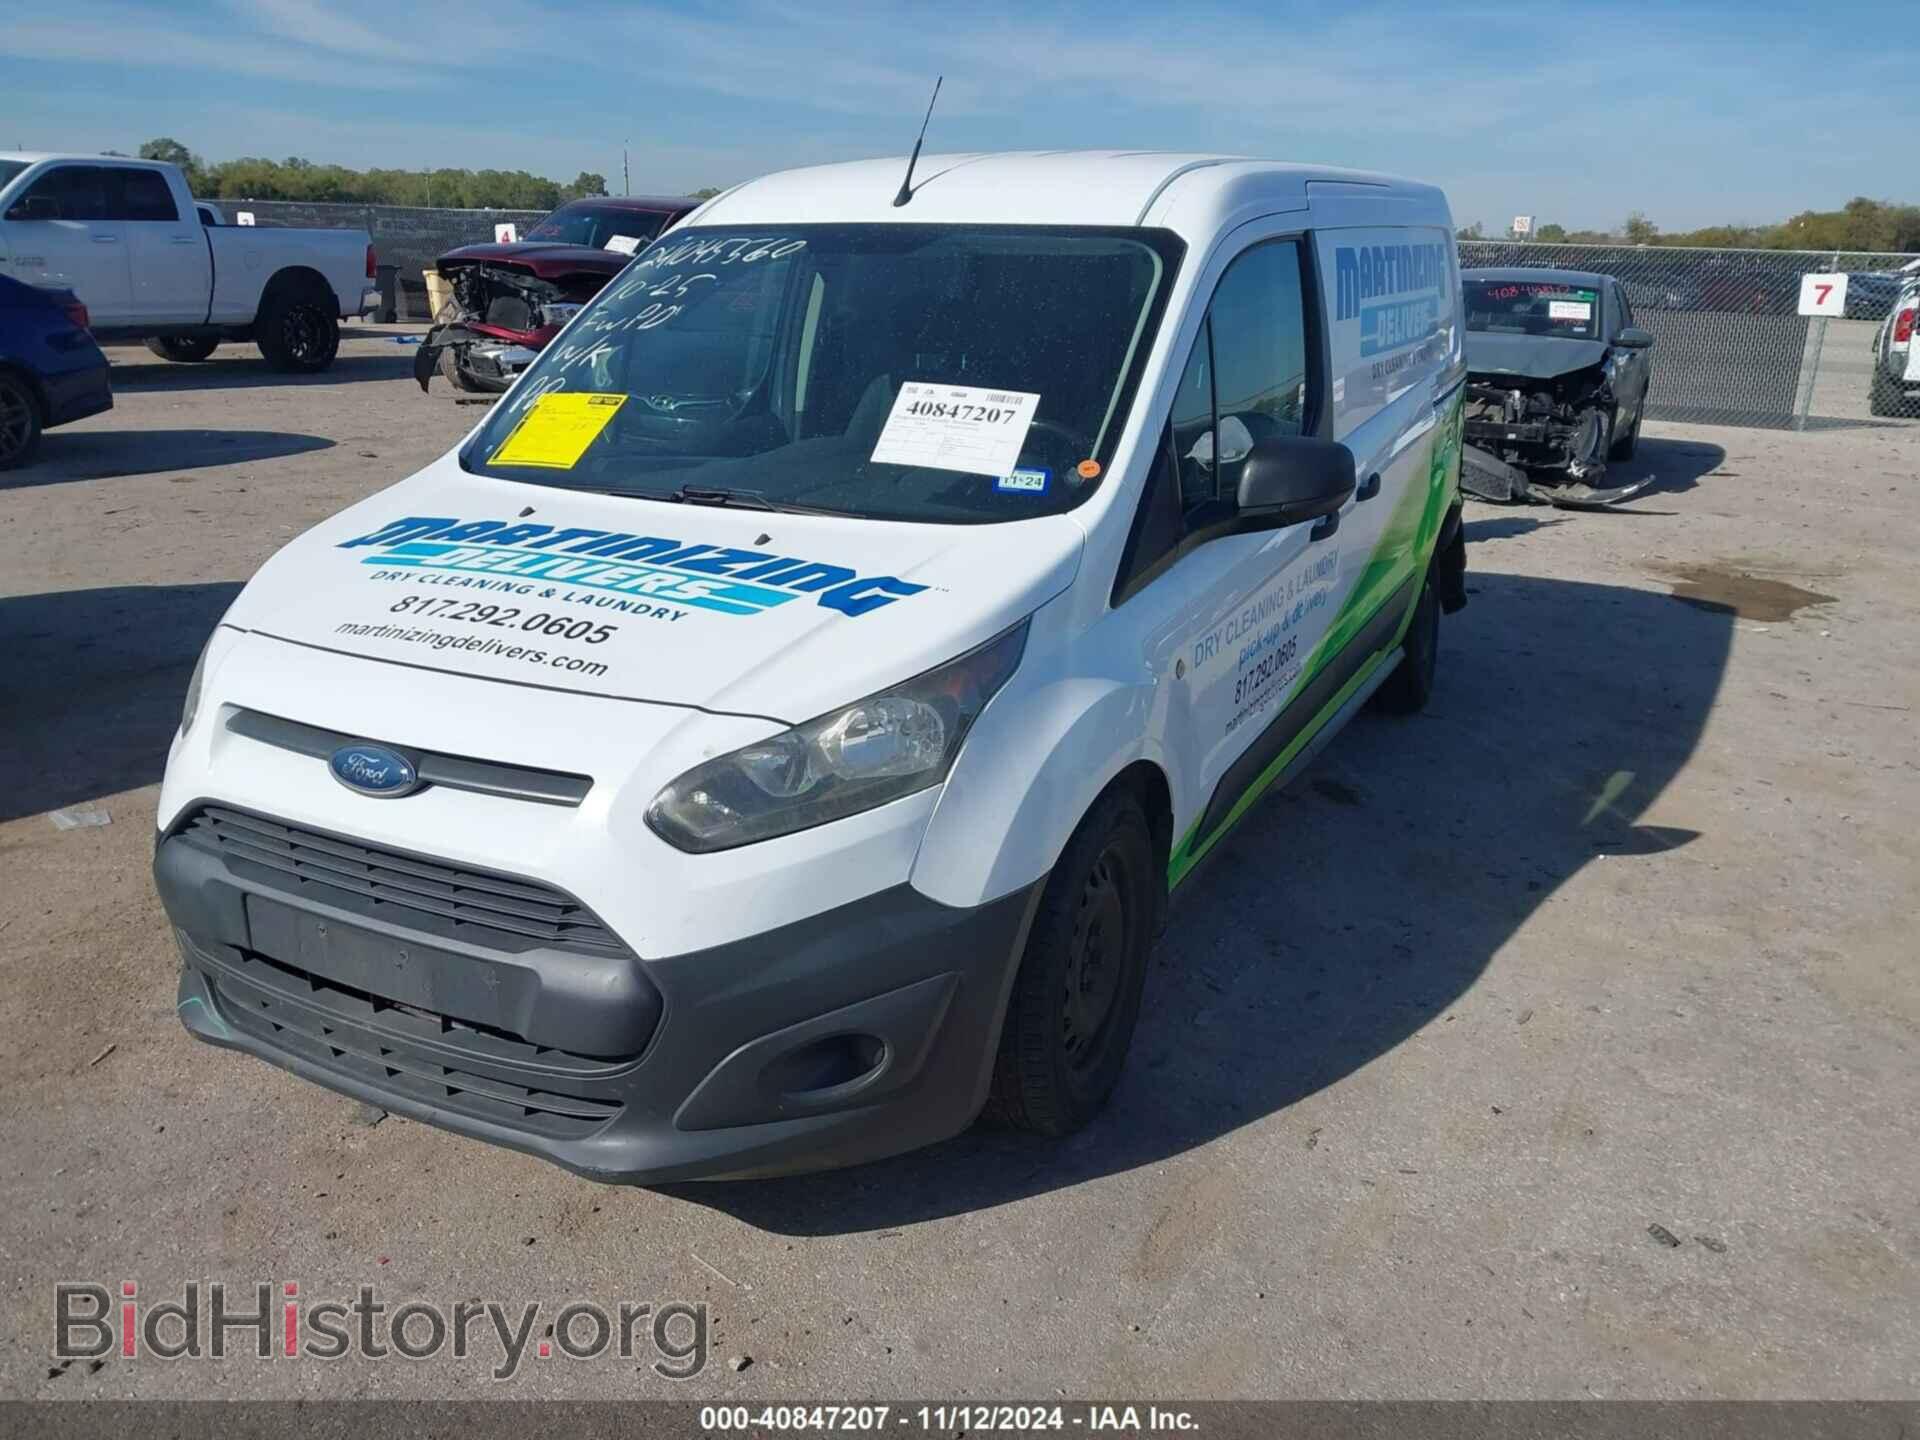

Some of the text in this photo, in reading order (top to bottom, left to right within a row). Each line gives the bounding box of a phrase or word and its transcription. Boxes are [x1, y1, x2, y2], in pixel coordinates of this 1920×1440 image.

[1815, 284, 1833, 305] 7
[905, 400, 1017, 425] 40847207
[334, 516, 931, 618] MARTINIZING
[421, 547, 735, 602] DELIVERS
[370, 570, 688, 622] DRY CLEANING & LAUNDRY
[389, 595, 618, 645] 817.292.0605
[334, 622, 609, 677] martinizingdelivers.com
[1195, 629, 1222, 669] DRY
[1226, 585, 1284, 645] CLEANING
[1235, 634, 1297, 705] 817.292.0605
[342, 752, 389, 785] Ford
